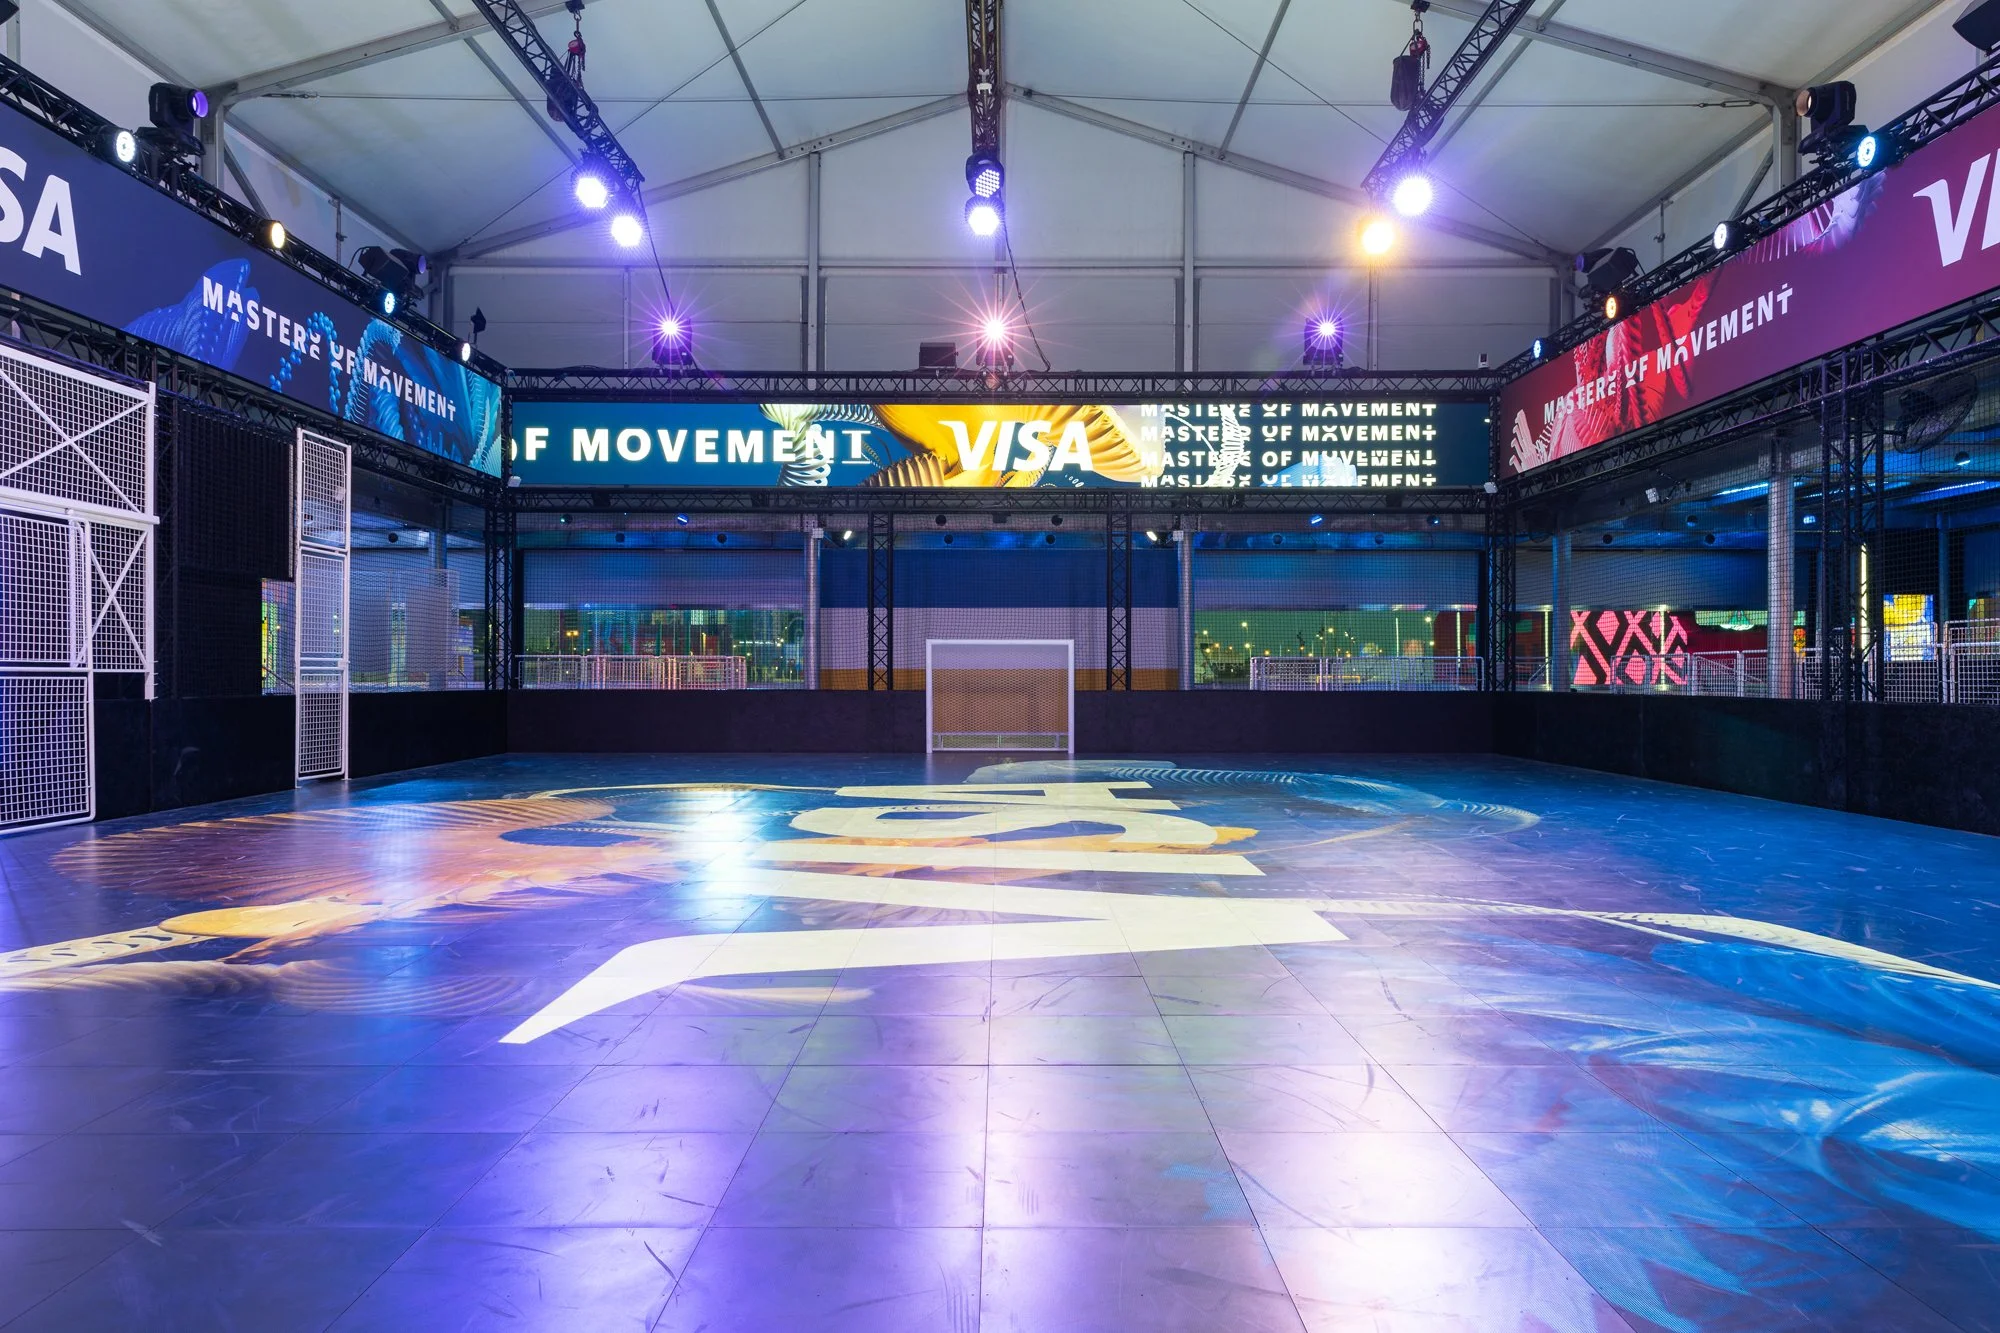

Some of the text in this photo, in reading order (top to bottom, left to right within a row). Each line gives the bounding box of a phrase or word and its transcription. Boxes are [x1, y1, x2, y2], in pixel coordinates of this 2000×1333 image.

[203, 275, 321, 361] MASTERS
[363, 357, 456, 422] MOVEMENT
[1544, 283, 1793, 424] MASTERS OF MOVEMENT
[1302, 403, 1437, 417] MOVEMENT
[572, 428, 871, 464] MOVEMENT
[938, 420, 1094, 472] VISA
[1262, 425, 1292, 442] OF
[1302, 425, 1437, 442] MOVEMENT
[1262, 451, 1292, 467] OF
[1302, 450, 1437, 467] MOVEMENT
